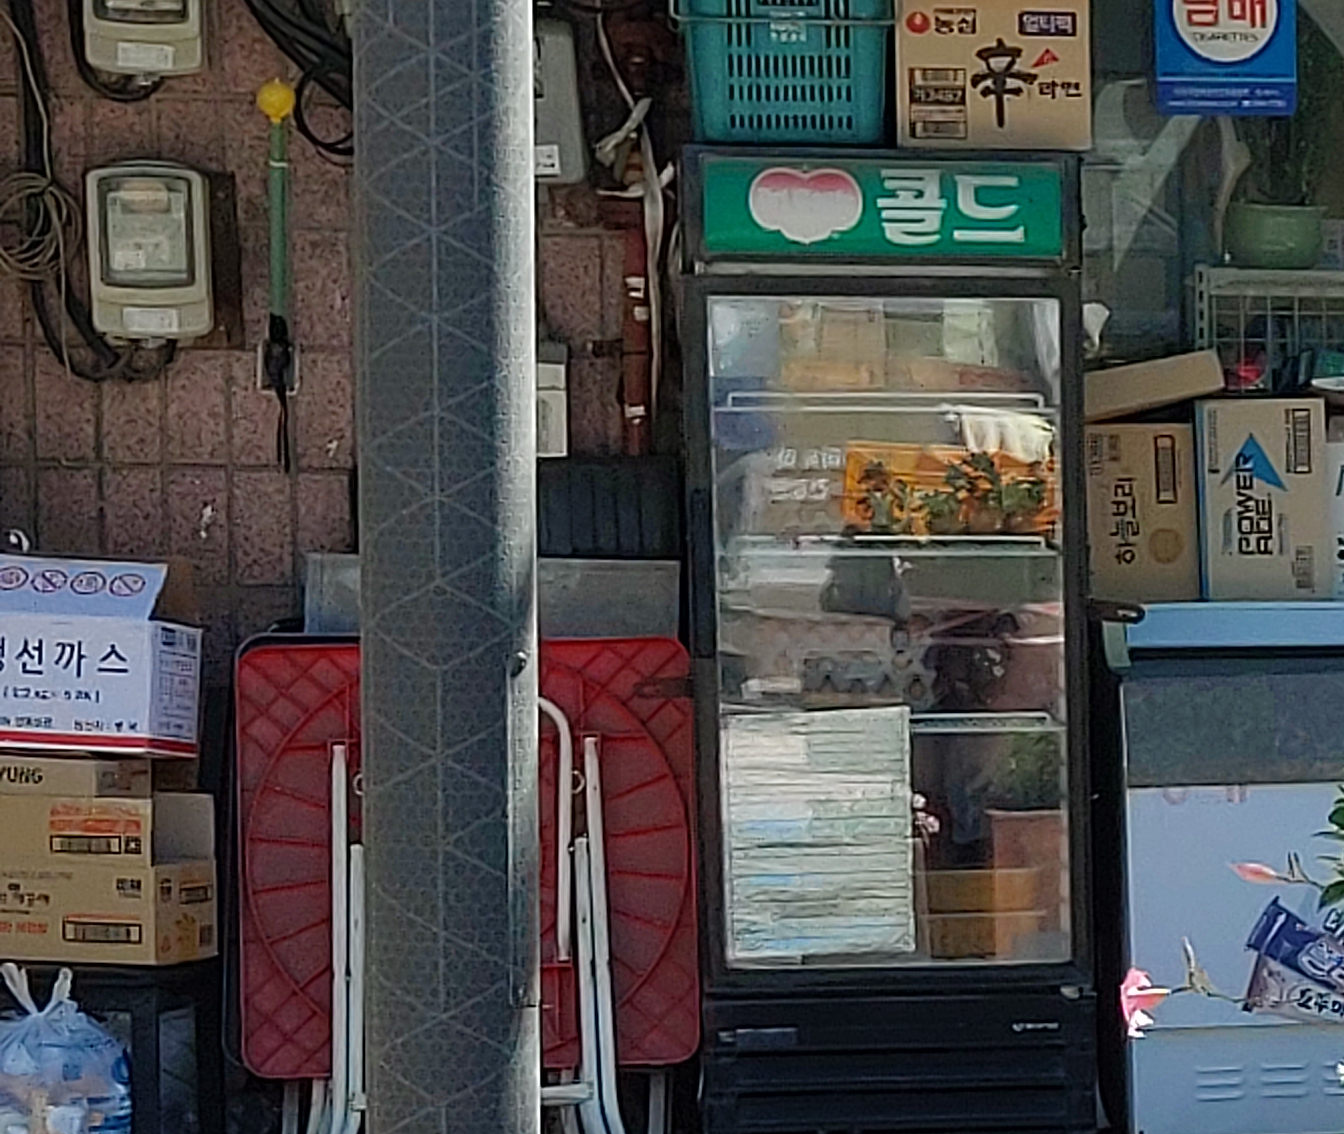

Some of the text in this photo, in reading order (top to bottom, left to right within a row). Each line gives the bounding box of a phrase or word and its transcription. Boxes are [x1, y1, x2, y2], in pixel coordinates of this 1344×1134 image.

[970, 37, 1039, 129] 辛
[876, 167, 1027, 246] 콜드
[1109, 477, 1140, 565] 하늘보리
[1235, 452, 1255, 556] POWER
